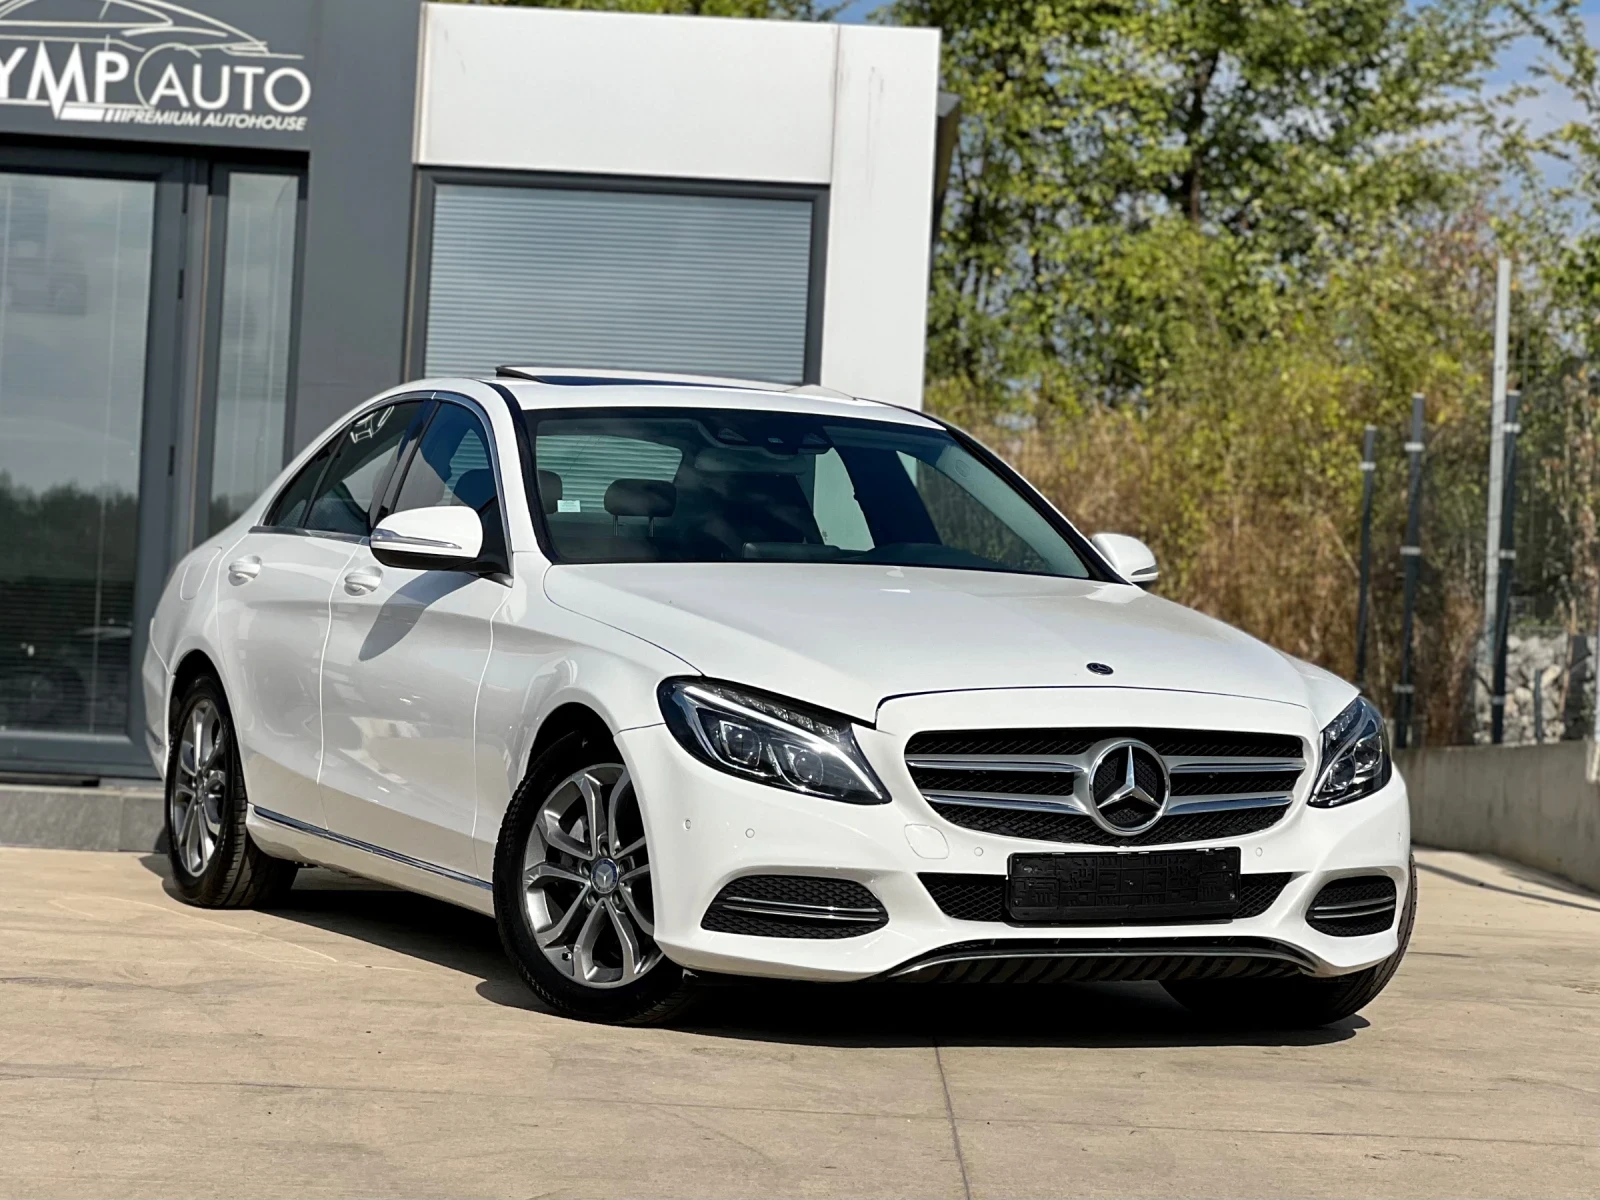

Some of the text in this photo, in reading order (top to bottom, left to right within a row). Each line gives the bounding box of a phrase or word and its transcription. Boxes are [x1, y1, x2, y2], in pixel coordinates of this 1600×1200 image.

[149, 62, 312, 113] AUTO
[124, 109, 308, 131] PREMIUM AUTOHOUSE
